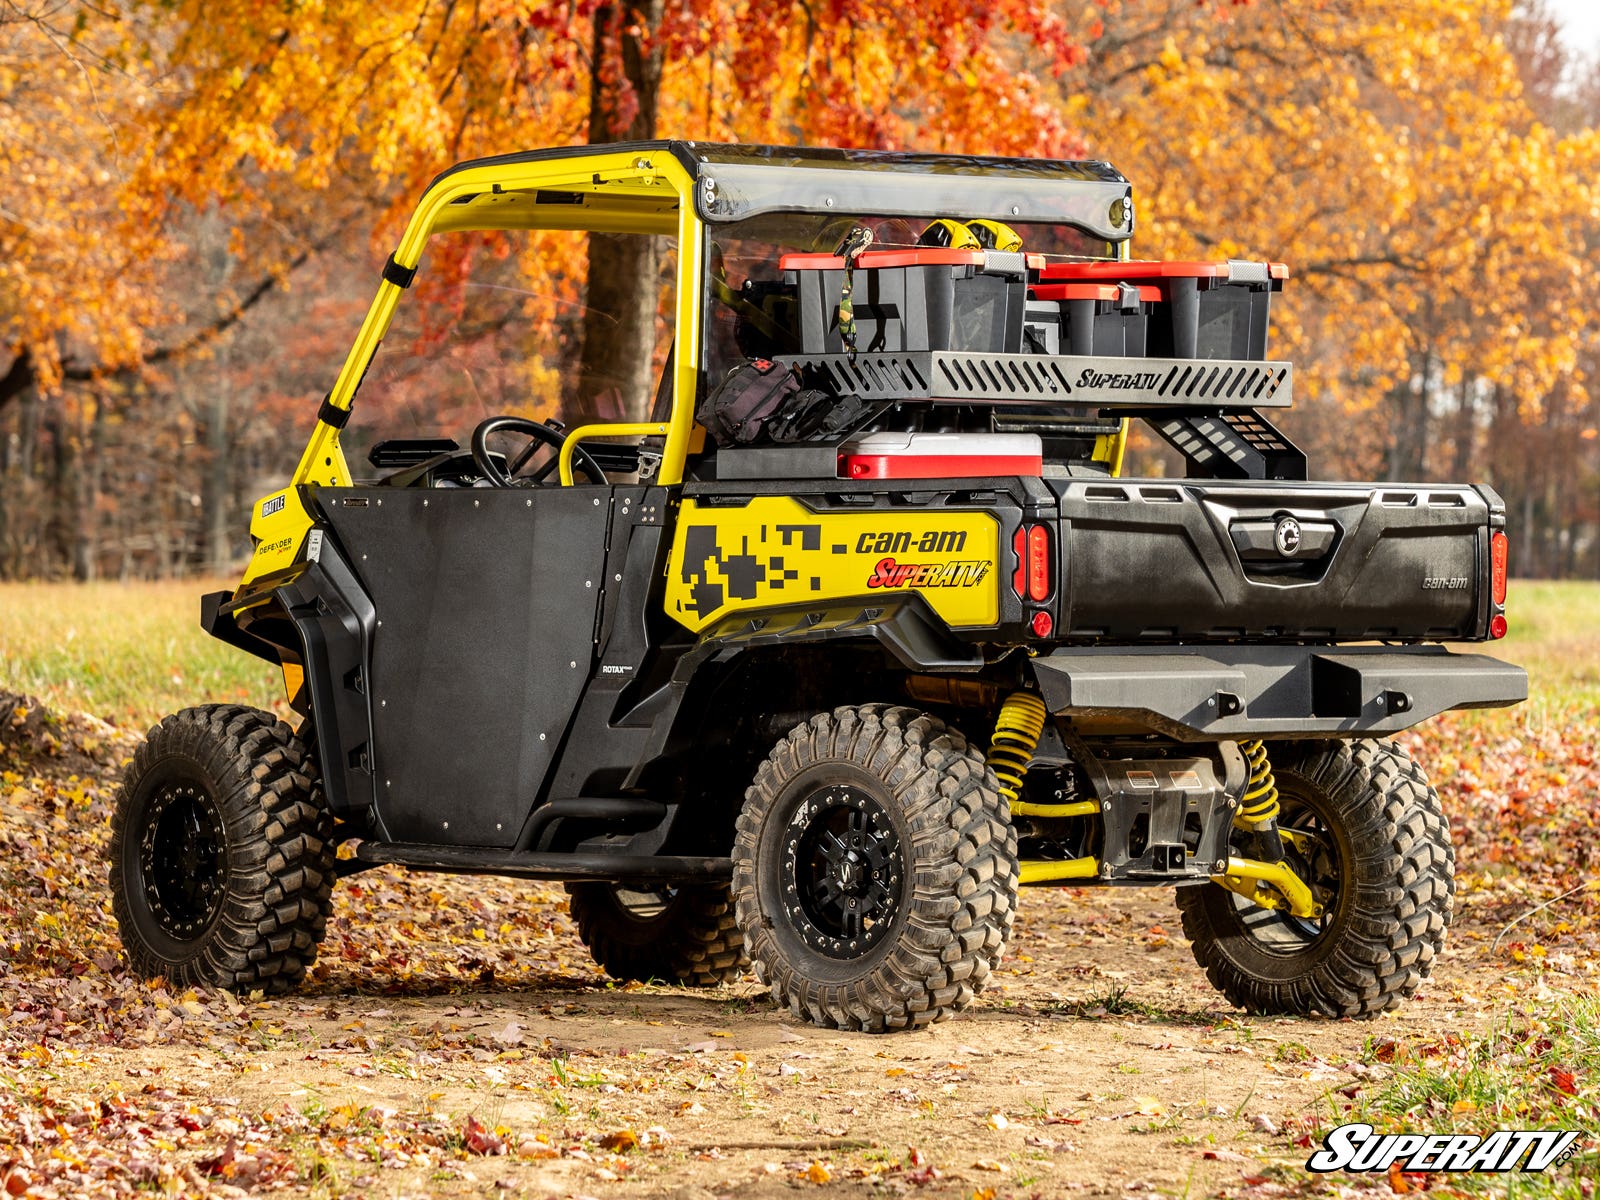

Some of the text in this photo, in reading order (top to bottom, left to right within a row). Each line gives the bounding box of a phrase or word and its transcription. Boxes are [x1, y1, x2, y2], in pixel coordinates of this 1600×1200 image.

[1076, 368, 1161, 390] SUPERATV
[259, 537, 292, 554] DEFENDER
[855, 530, 967, 553] can-am
[867, 557, 989, 588] SUPERATV
[1422, 577, 1468, 590] can-am
[602, 665, 624, 674] ROTAX
